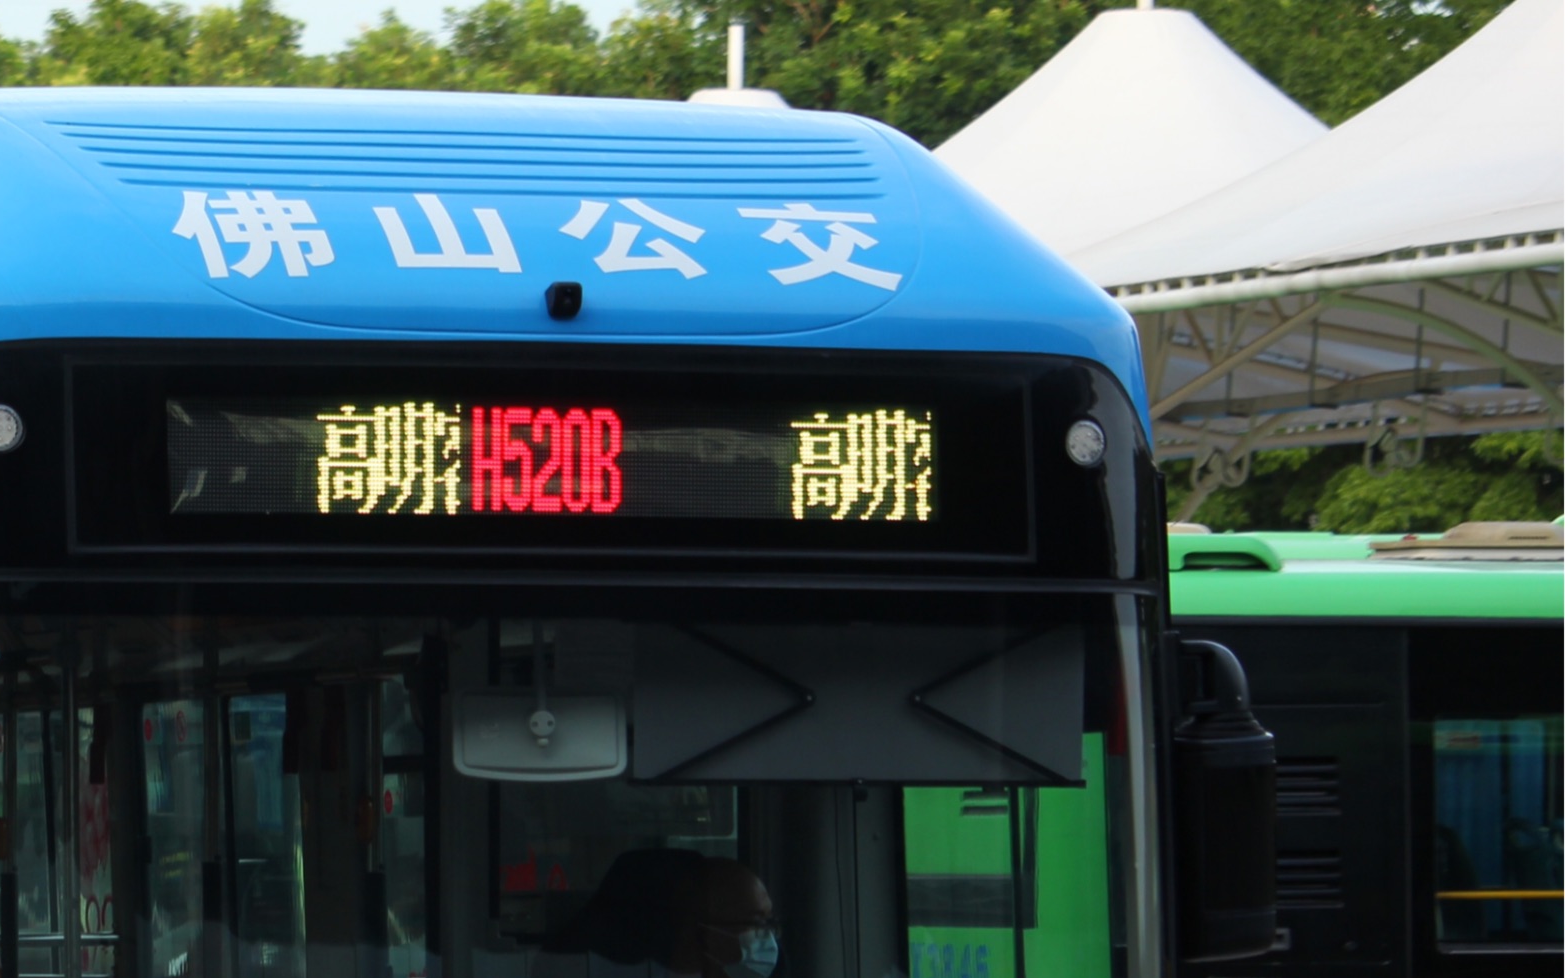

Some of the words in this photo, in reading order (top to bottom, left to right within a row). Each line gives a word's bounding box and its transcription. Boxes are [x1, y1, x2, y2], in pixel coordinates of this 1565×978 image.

[172, 190, 903, 292] 佛山公交
[472, 406, 623, 513] H520B
